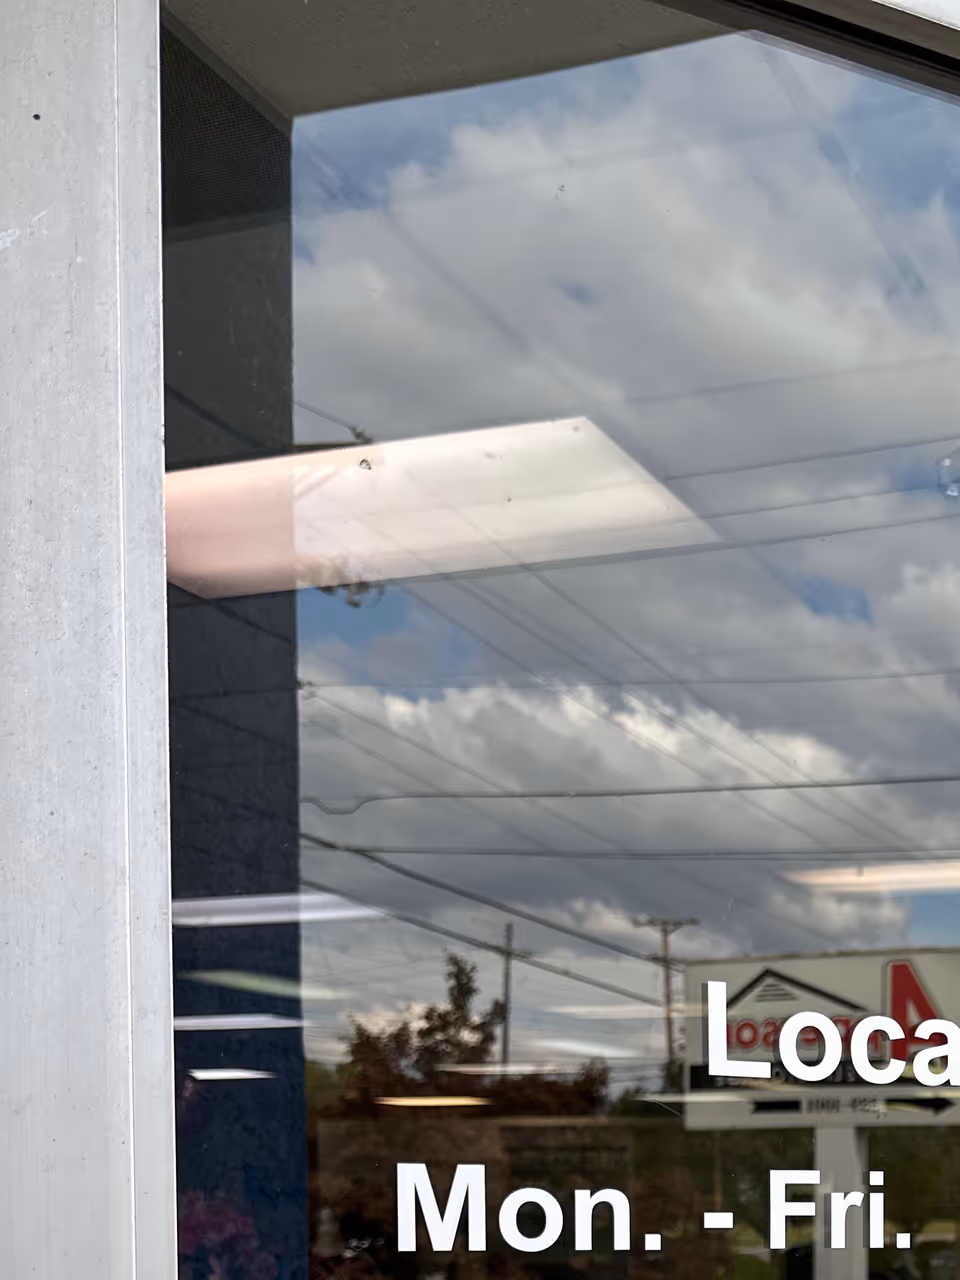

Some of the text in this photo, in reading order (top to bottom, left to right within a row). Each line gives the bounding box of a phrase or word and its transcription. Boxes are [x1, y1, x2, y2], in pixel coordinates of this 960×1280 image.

[398, 1164, 660, 1251] Mon.
[705, 1213, 733, 1228] -
[771, 1170, 910, 1251] Fri.
